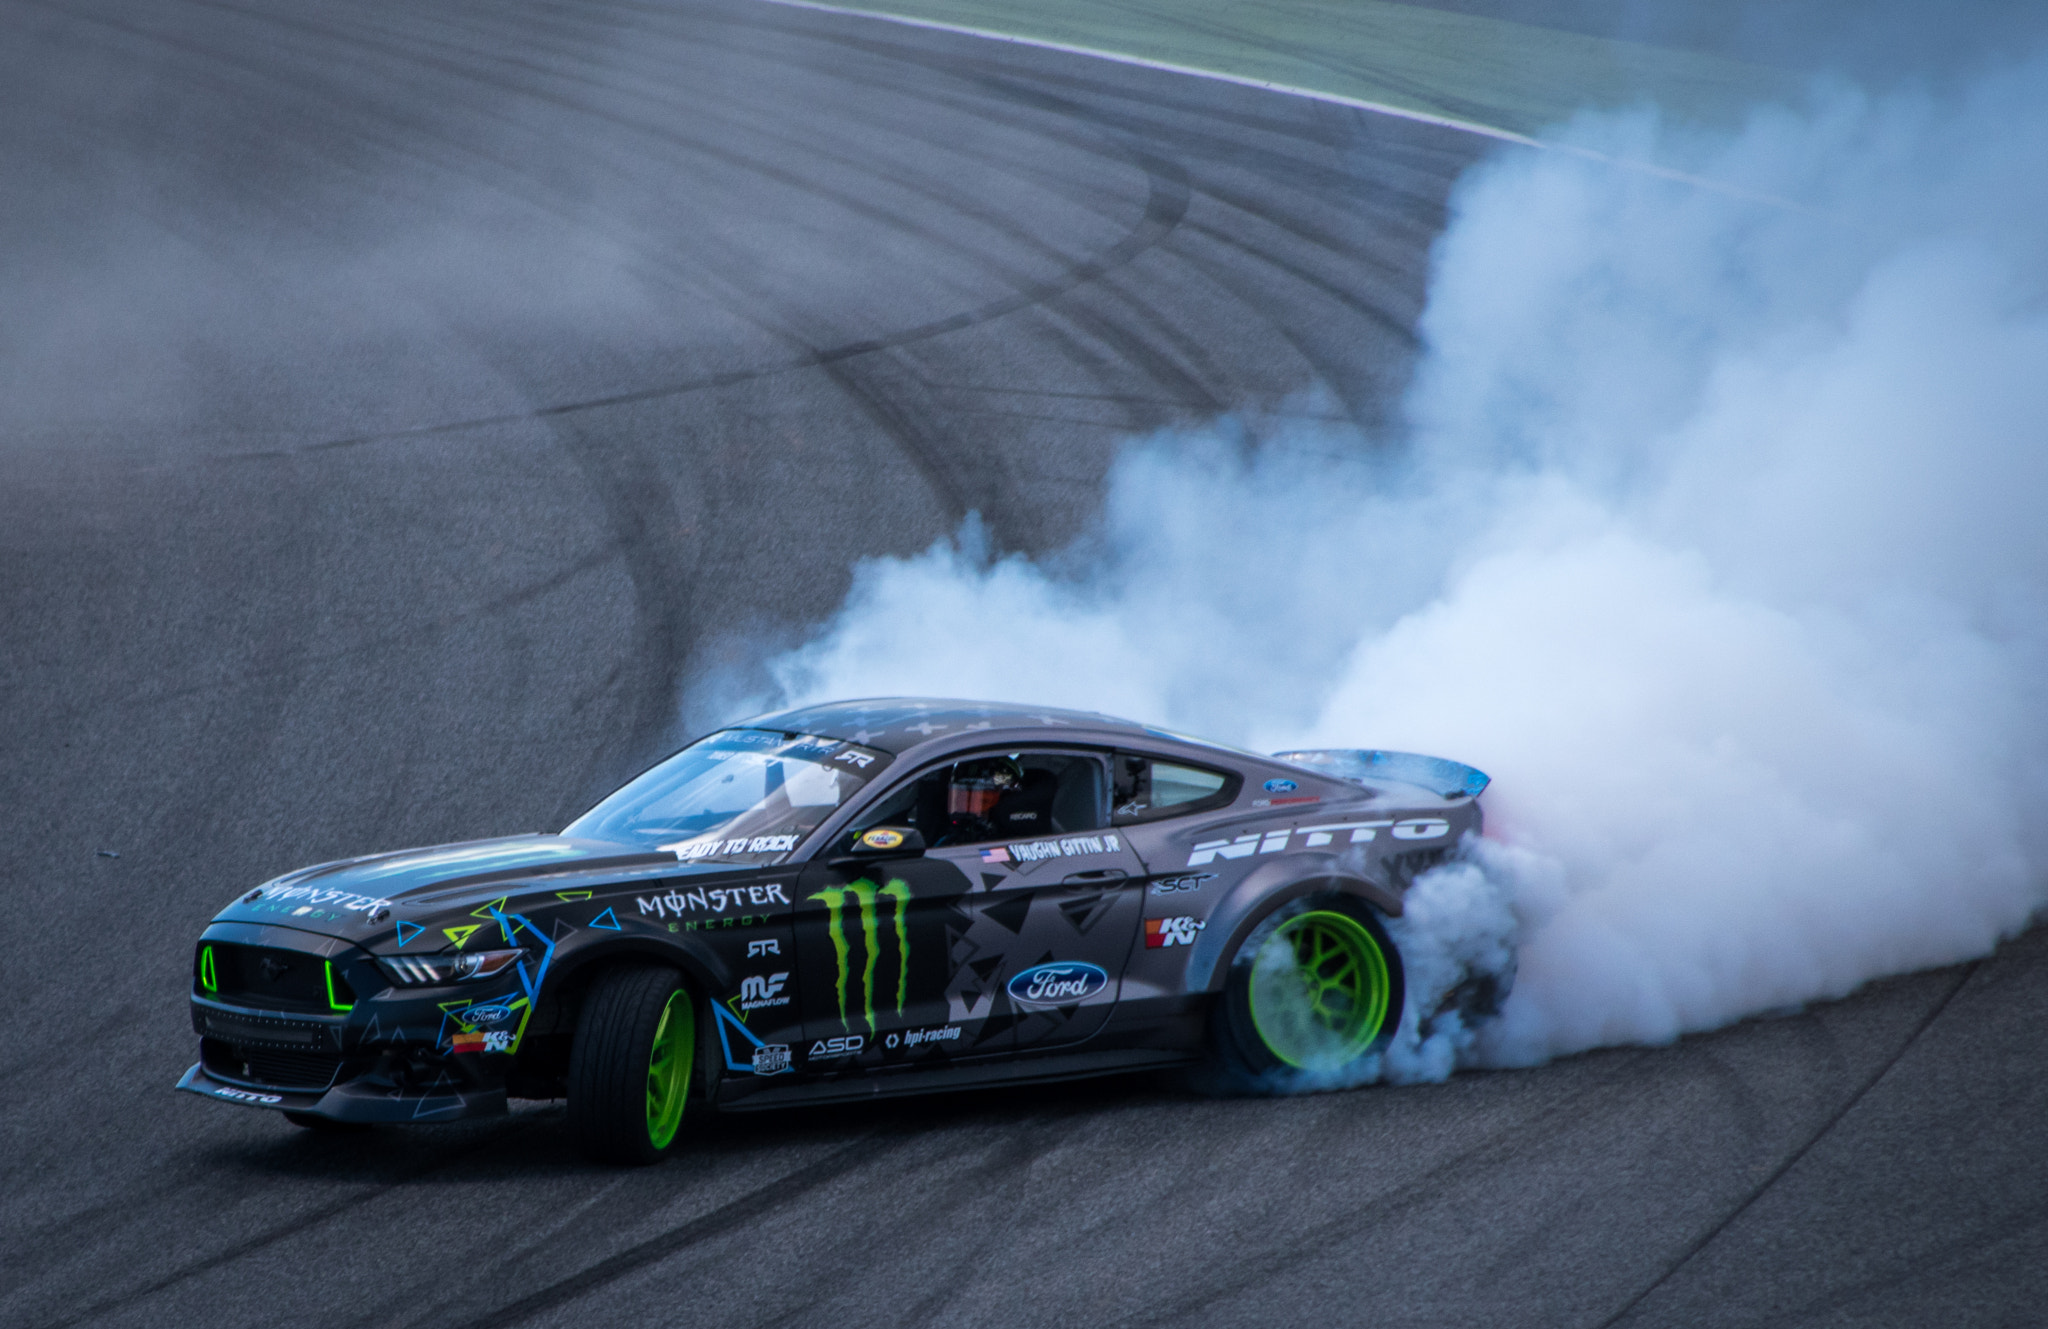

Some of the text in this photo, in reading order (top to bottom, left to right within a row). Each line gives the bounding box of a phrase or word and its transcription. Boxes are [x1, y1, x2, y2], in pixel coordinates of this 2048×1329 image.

[676, 834, 800, 861] EADY TO ROCK
[1008, 834, 1121, 862] VAUGHN GITTIN JR
[1187, 818, 1450, 867] NITTO
[1156, 874, 1212, 894] SCT
[264, 885, 393, 918] MONSTER
[636, 883, 791, 918] MONSTER
[251, 903, 342, 921] ENEGY
[668, 914, 771, 933] ENERGY
[1159, 916, 1207, 947] K&N
[1026, 967, 1089, 1000] Ford
[471, 1007, 502, 1022] Ford
[741, 996, 790, 1011] MAGNAFLOW
[482, 1030, 517, 1052] K&N
[808, 1035, 864, 1056] ASD
[904, 1025, 962, 1047] hpi-racing
[758, 1053, 785, 1063] SPEED
[214, 1086, 283, 1103] NITTO
